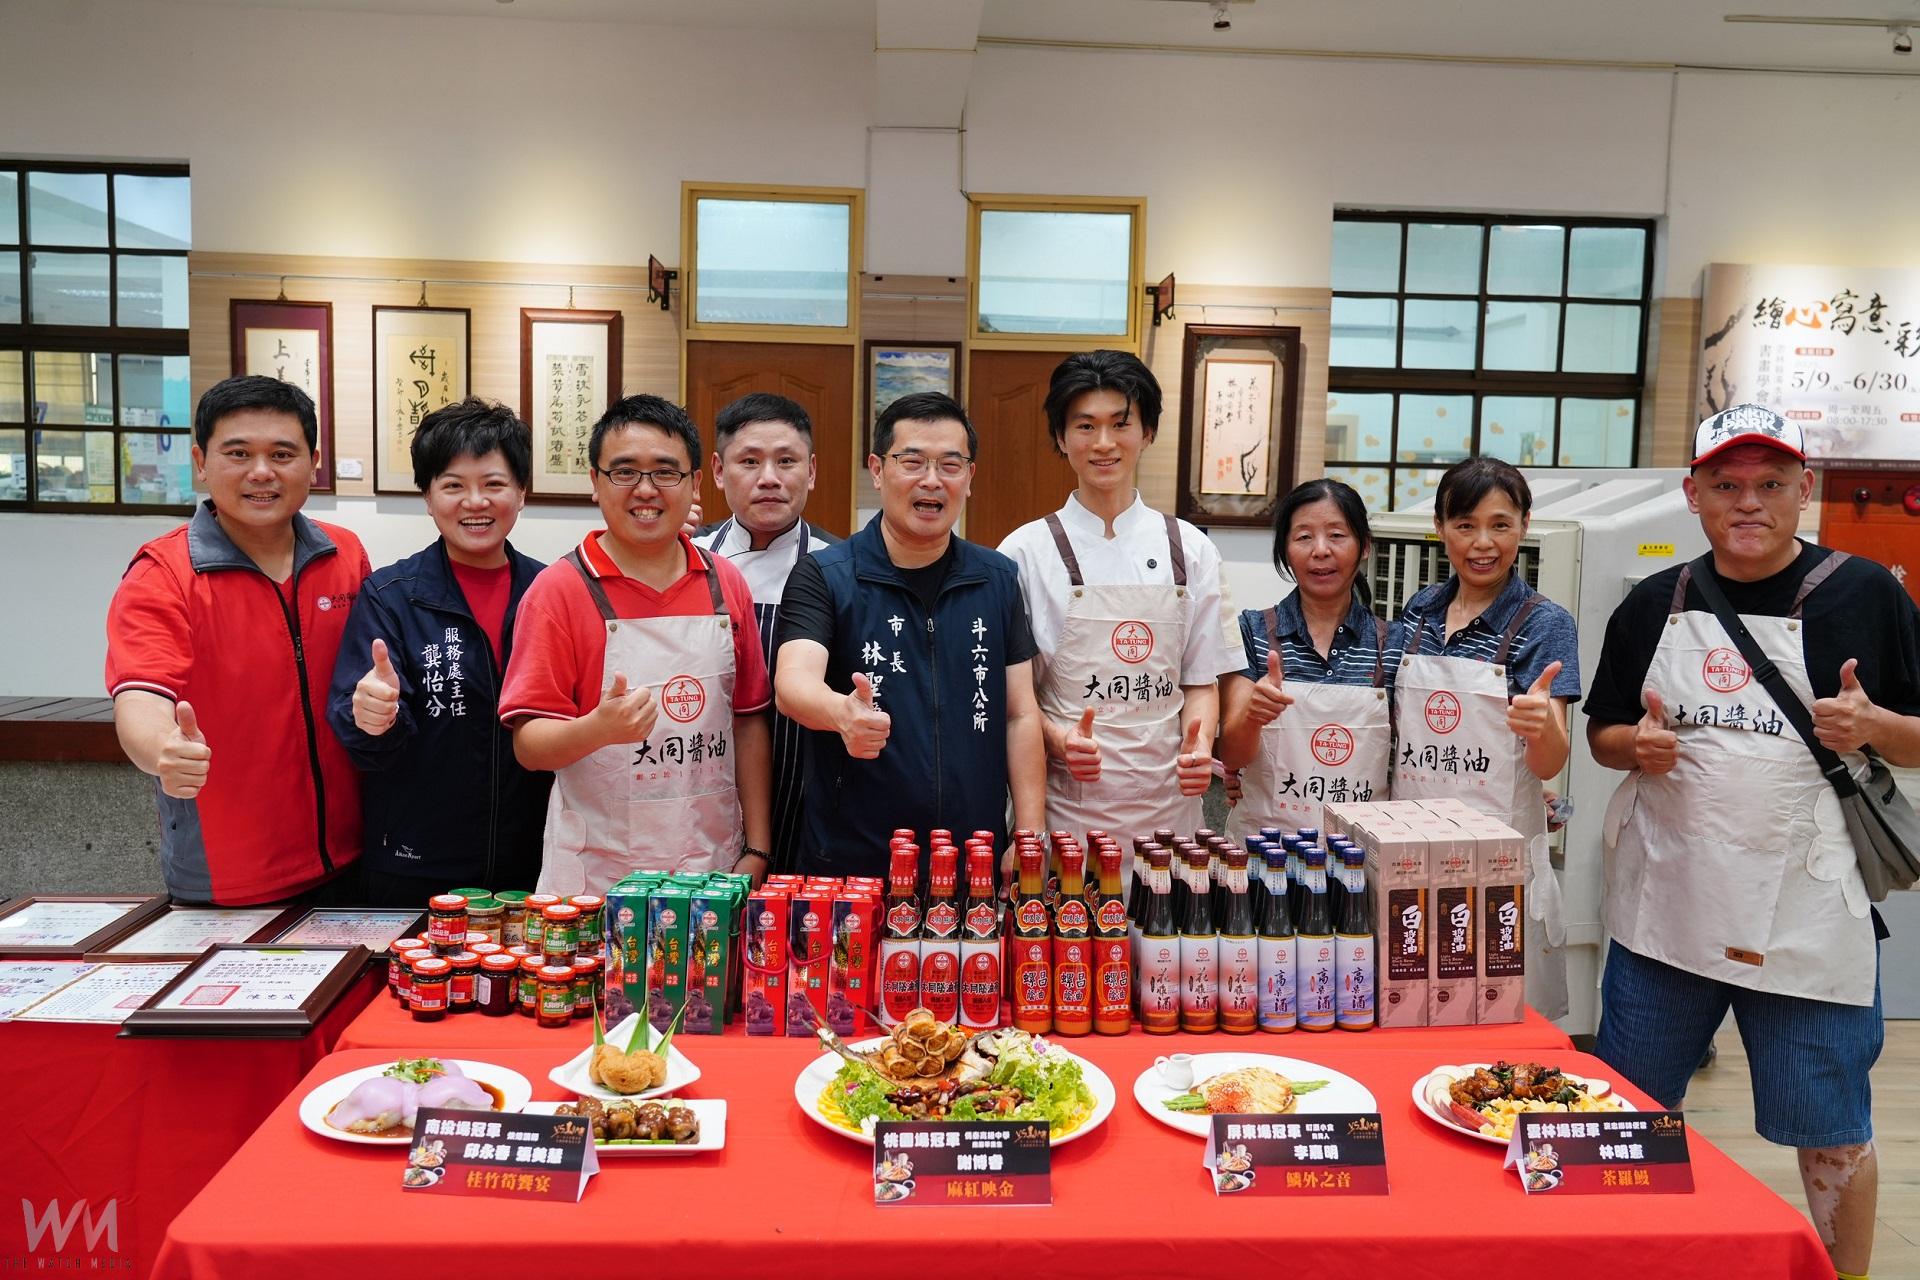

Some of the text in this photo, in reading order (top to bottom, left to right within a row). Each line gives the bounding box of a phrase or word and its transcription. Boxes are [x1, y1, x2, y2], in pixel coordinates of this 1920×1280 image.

[887, 614, 907, 673] 市長
[421, 643, 446, 718] 龔怡分
[444, 626, 466, 717] 服務處主任
[971, 617, 989, 732] 斗六市公所
[1083, 672, 1173, 702] 大同醬油
[632, 731, 726, 766] 大同醬油
[1401, 743, 1490, 774] 大同醬油
[1279, 772, 1373, 803] 大同醬油
[1402, 905, 1422, 954] 白醬油
[1450, 903, 1470, 953] 白醬油
[1499, 901, 1518, 951] 白醬油
[668, 938, 680, 965] 台灣
[707, 940, 720, 967] 台灣
[425, 1119, 502, 1138] 南投場冠軍
[1228, 1124, 1302, 1140] 屏東場冠軍
[466, 1170, 550, 1193] 桂竹筍饗宴
[947, 1181, 1014, 1198] 麻紅映金
